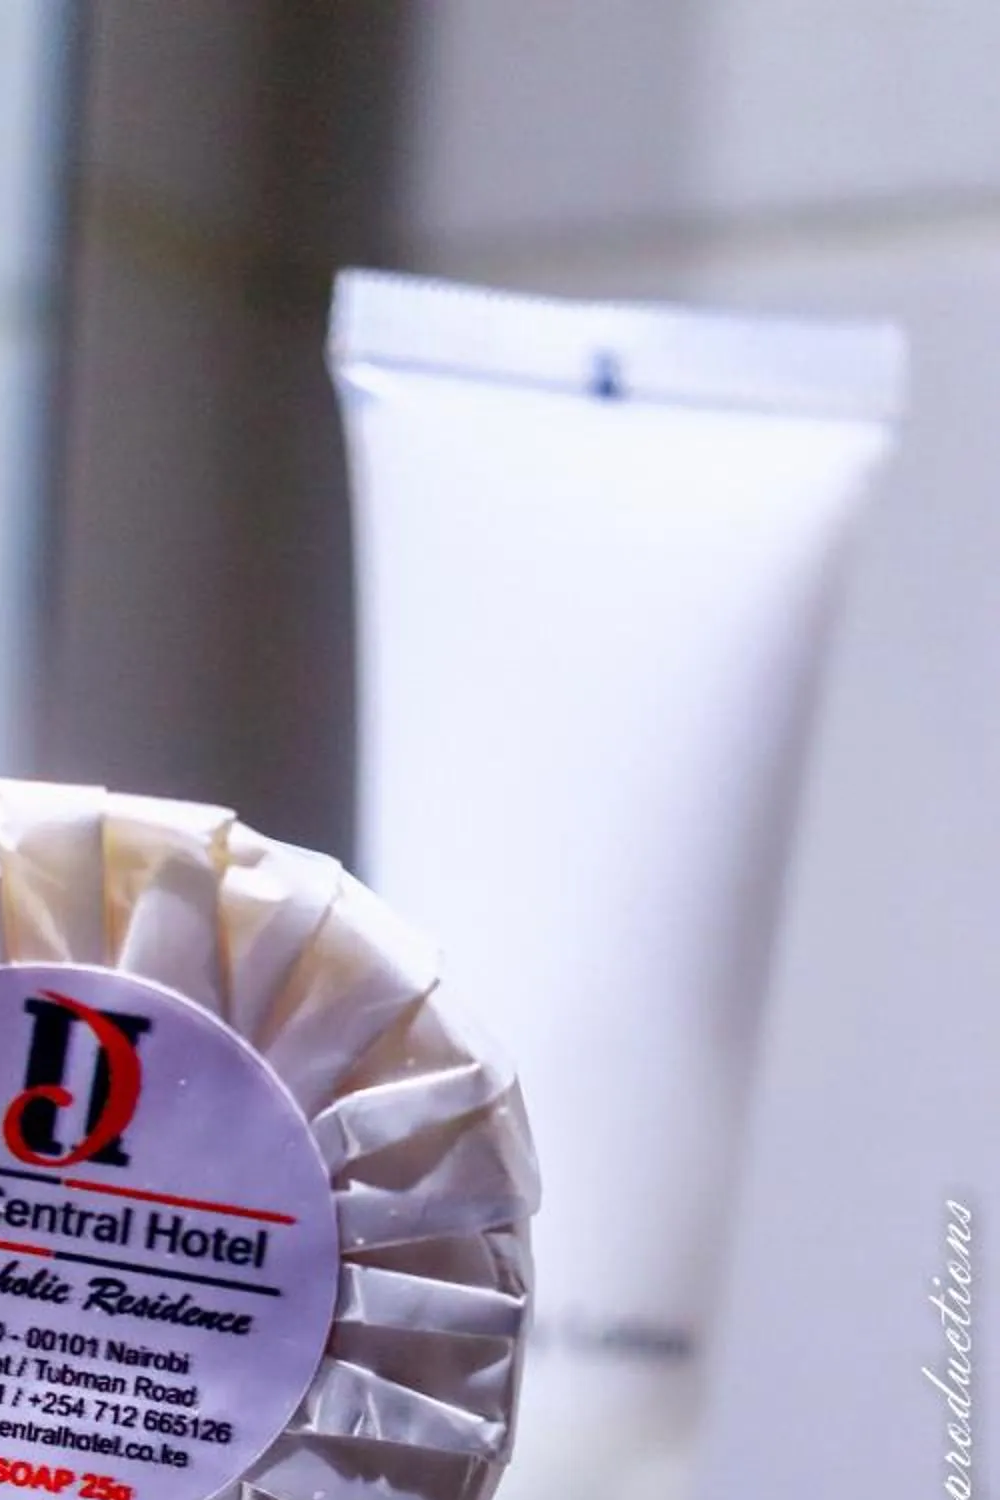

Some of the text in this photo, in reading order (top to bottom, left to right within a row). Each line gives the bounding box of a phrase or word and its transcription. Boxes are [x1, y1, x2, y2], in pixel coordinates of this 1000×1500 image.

[145, 1210, 269, 1270] Hotel
[81, 1276, 254, 1336] Residence
[26, 1327, 99, 1359] 00101
[105, 1340, 191, 1376] Nairobi
[33, 1357, 127, 1395] Tubman
[134, 1375, 198, 1408] Road
[28, 1391, 85, 1419] +254
[94, 1400, 138, 1428] 712
[143, 1409, 233, 1445] 665126
